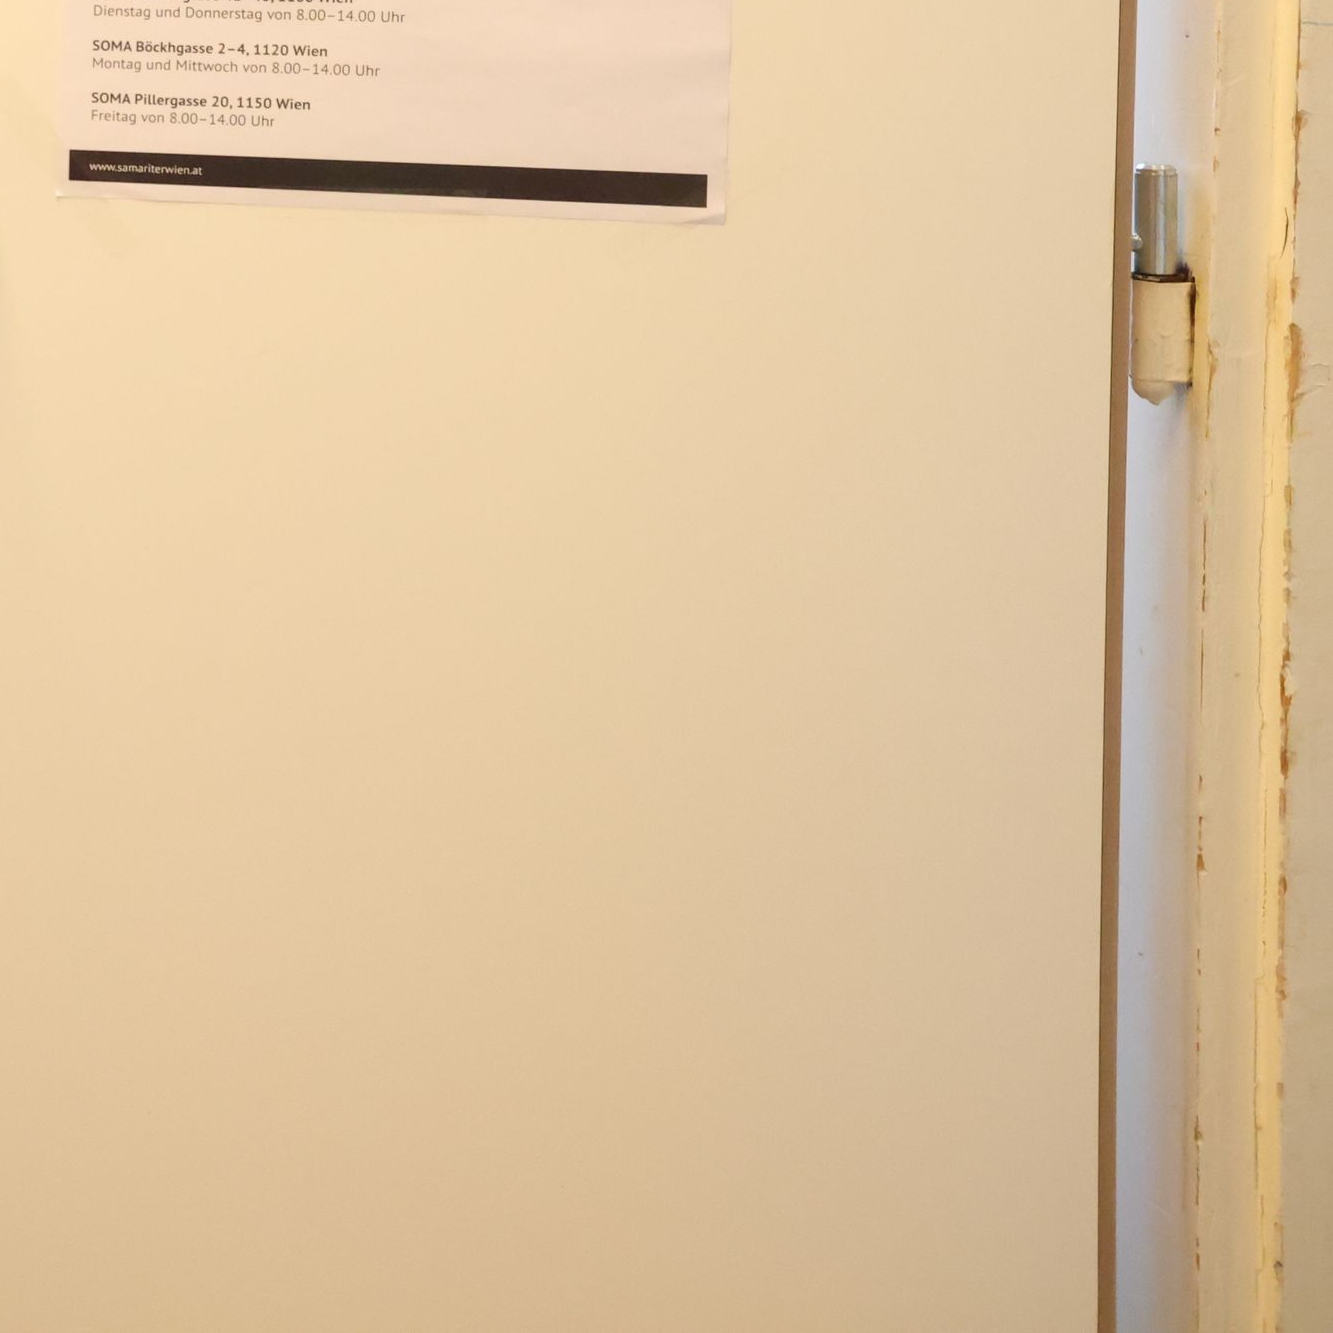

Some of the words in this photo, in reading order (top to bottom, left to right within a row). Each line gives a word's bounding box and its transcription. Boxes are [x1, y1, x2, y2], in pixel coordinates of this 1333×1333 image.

[94, 5, 150, 20] Dienstag
[156, 7, 180, 18] und
[186, 6, 262, 23] Donnerstag
[267, 11, 291, 20] von
[297, 9, 375, 22] 8.00–14.00
[381, 11, 405, 23] Uhr
[93, 40, 132, 51] SOMA
[136, 41, 213, 56] Böckhgasse
[218, 43, 249, 56] 2–4,
[254, 44, 288, 56] 1120
[293, 45, 327, 56] Wien
[93, 57, 141, 73] Montag
[146, 59, 171, 70] und
[176, 59, 238, 72] Mittwoch
[243, 64, 266, 73] von
[272, 62, 350, 76] 8.00–14.00
[356, 65, 380, 76] Uhr
[92, 92, 130, 104] SOMA
[135, 94, 207, 109] Pillergasse
[212, 96, 232, 109] 20,
[237, 97, 271, 109] 1150
[276, 98, 310, 110] Wien
[91, 109, 136, 125] Freitag
[141, 114, 164, 123] von
[170, 112, 246, 126] 8.00–14.00
[251, 115, 275, 127] Uhr
[89, 164, 202, 175] www.samariterwien.at
